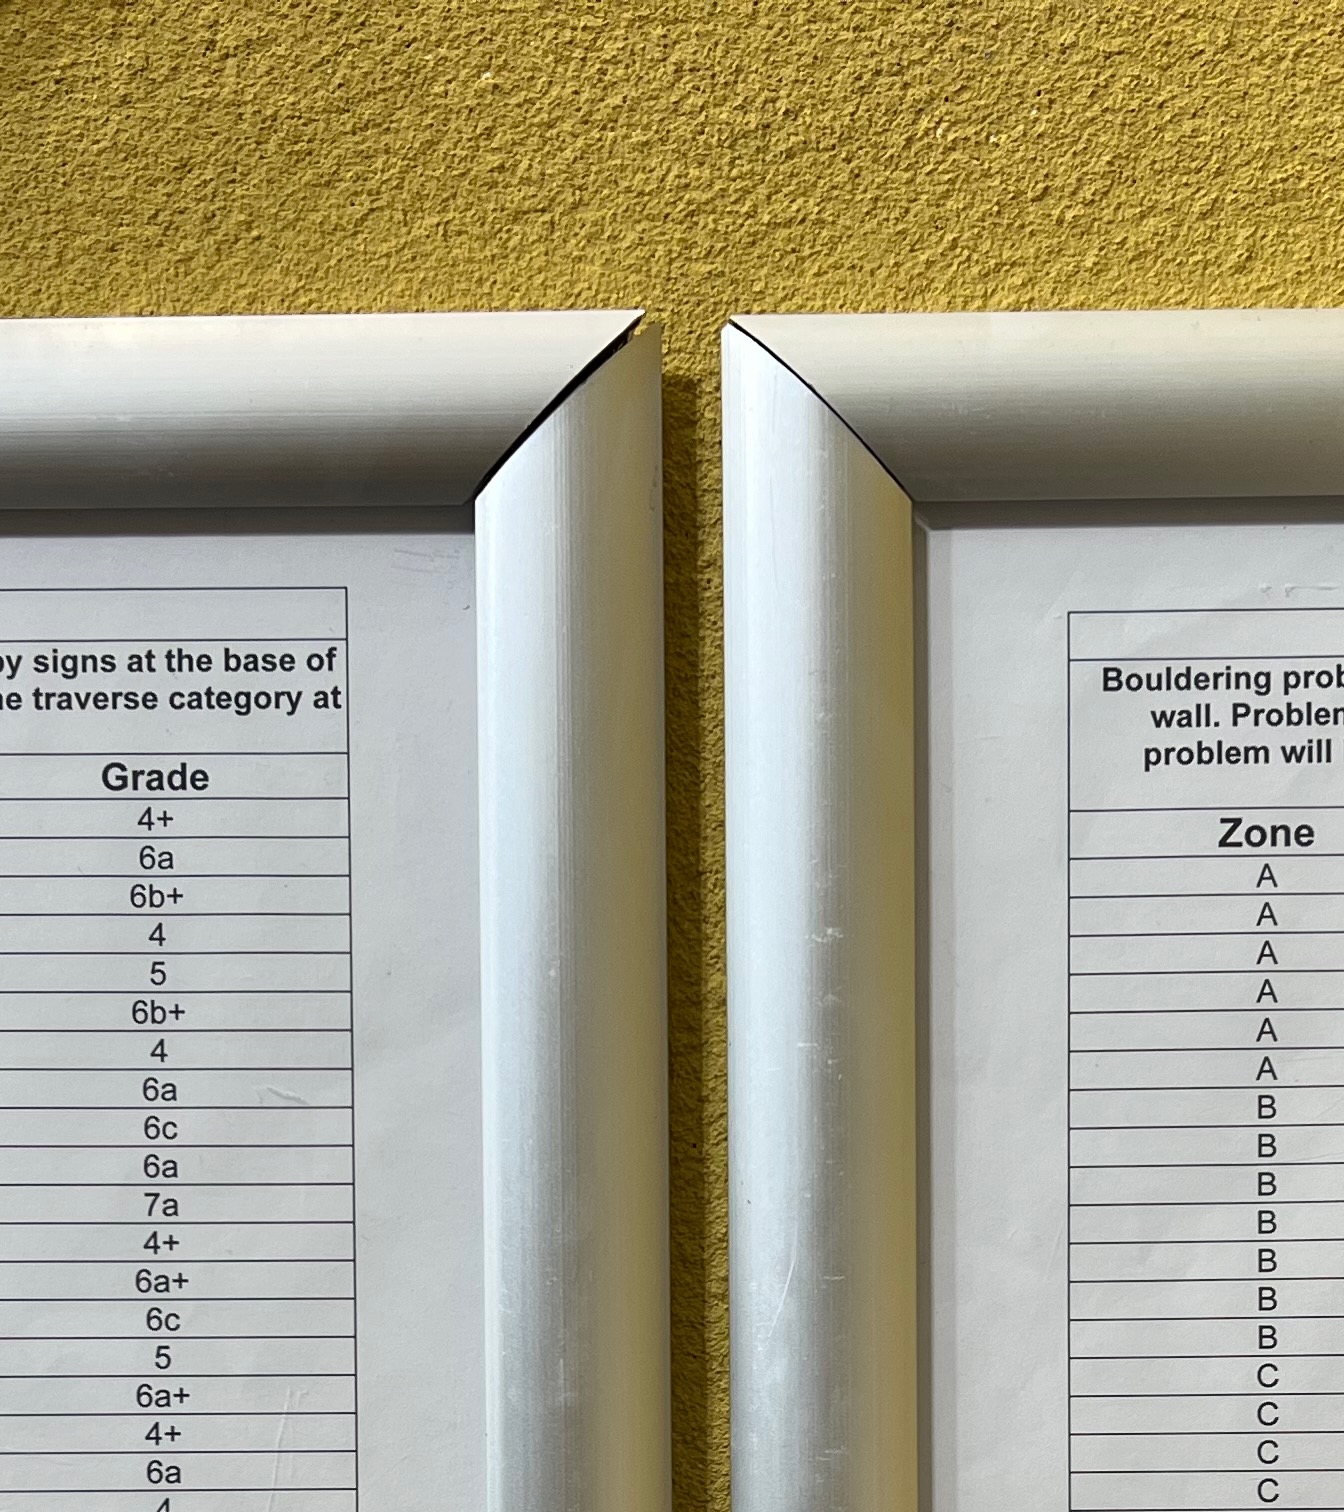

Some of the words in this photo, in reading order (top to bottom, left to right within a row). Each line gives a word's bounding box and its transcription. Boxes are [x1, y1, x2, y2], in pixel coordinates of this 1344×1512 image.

[33, 648, 117, 680] signs
[127, 649, 157, 673] at
[164, 647, 213, 673] the
[223, 647, 296, 673] base
[306, 646, 338, 672] of
[1102, 665, 1272, 697] Bouldering
[31, 686, 159, 711] traverse
[168, 686, 303, 717] category
[313, 685, 342, 710] at
[1150, 703, 1220, 729] wall.
[1144, 739, 1270, 773] problem
[1280, 738, 1332, 764] will
[101, 762, 210, 792] Grade
[137, 806, 174, 832] 4+
[1218, 817, 1315, 848] Zone
[1256, 862, 1278, 888] A
[130, 883, 184, 909] 6b+
[1256, 940, 1279, 965] A
[131, 999, 186, 1025] 6b+
[1257, 1094, 1277, 1120] B
[143, 1192, 179, 1217] 7a
[1257, 1209, 1277, 1235] B
[1257, 1363, 1279, 1388] C
[144, 1421, 182, 1446] 4+
[1257, 1477, 1280, 1503] C
